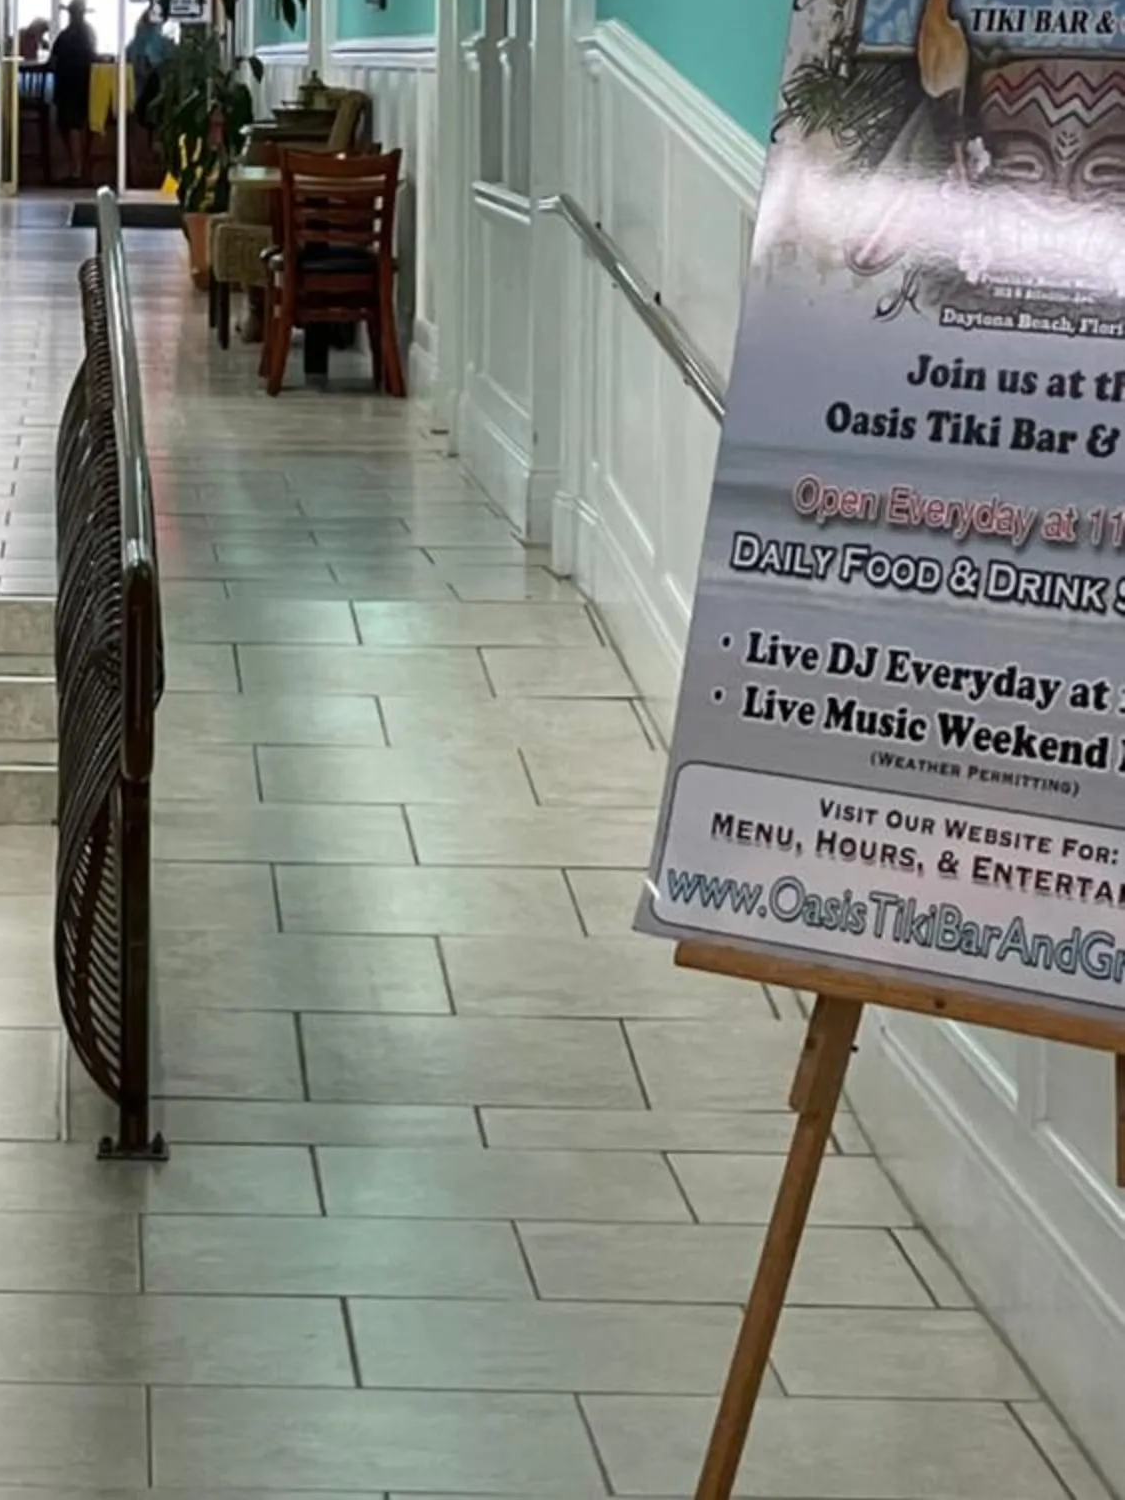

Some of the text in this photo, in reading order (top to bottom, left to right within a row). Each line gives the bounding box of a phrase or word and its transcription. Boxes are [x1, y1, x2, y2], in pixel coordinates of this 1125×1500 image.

[971, 7, 1026, 32] TIKI
[1034, 8, 1089, 35] BAR
[1095, 10, 1116, 34] &
[941, 307, 1014, 329] Daytona
[1018, 313, 1076, 334] Beach,
[907, 354, 987, 391] Join
[997, 369, 1039, 395] us
[1046, 370, 1087, 399] at
[826, 402, 1121, 458] Oasis Tiki Bar &
[793, 474, 878, 523] Open
[885, 484, 1038, 545] Everyday
[1041, 504, 1079, 542] at
[731, 532, 833, 580] DAILY
[840, 544, 942, 593] FOOD
[948, 557, 979, 597] &
[986, 560, 1109, 615] DRINK
[747, 631, 819, 672] Live
[827, 642, 878, 679] DJ
[885, 651, 1062, 711] Everyday
[1069, 680, 1111, 711] at
[743, 686, 816, 727] Live
[824, 698, 928, 742] Music
[937, 712, 1110, 770] Weekend
[869, 752, 1081, 798] (WEATHER PERMITTING)
[710, 813, 803, 852] MENU,
[816, 830, 925, 873] HOURS,
[936, 850, 960, 876] &
[819, 798, 1121, 866] VISIT OUR WEBSITE FOR:
